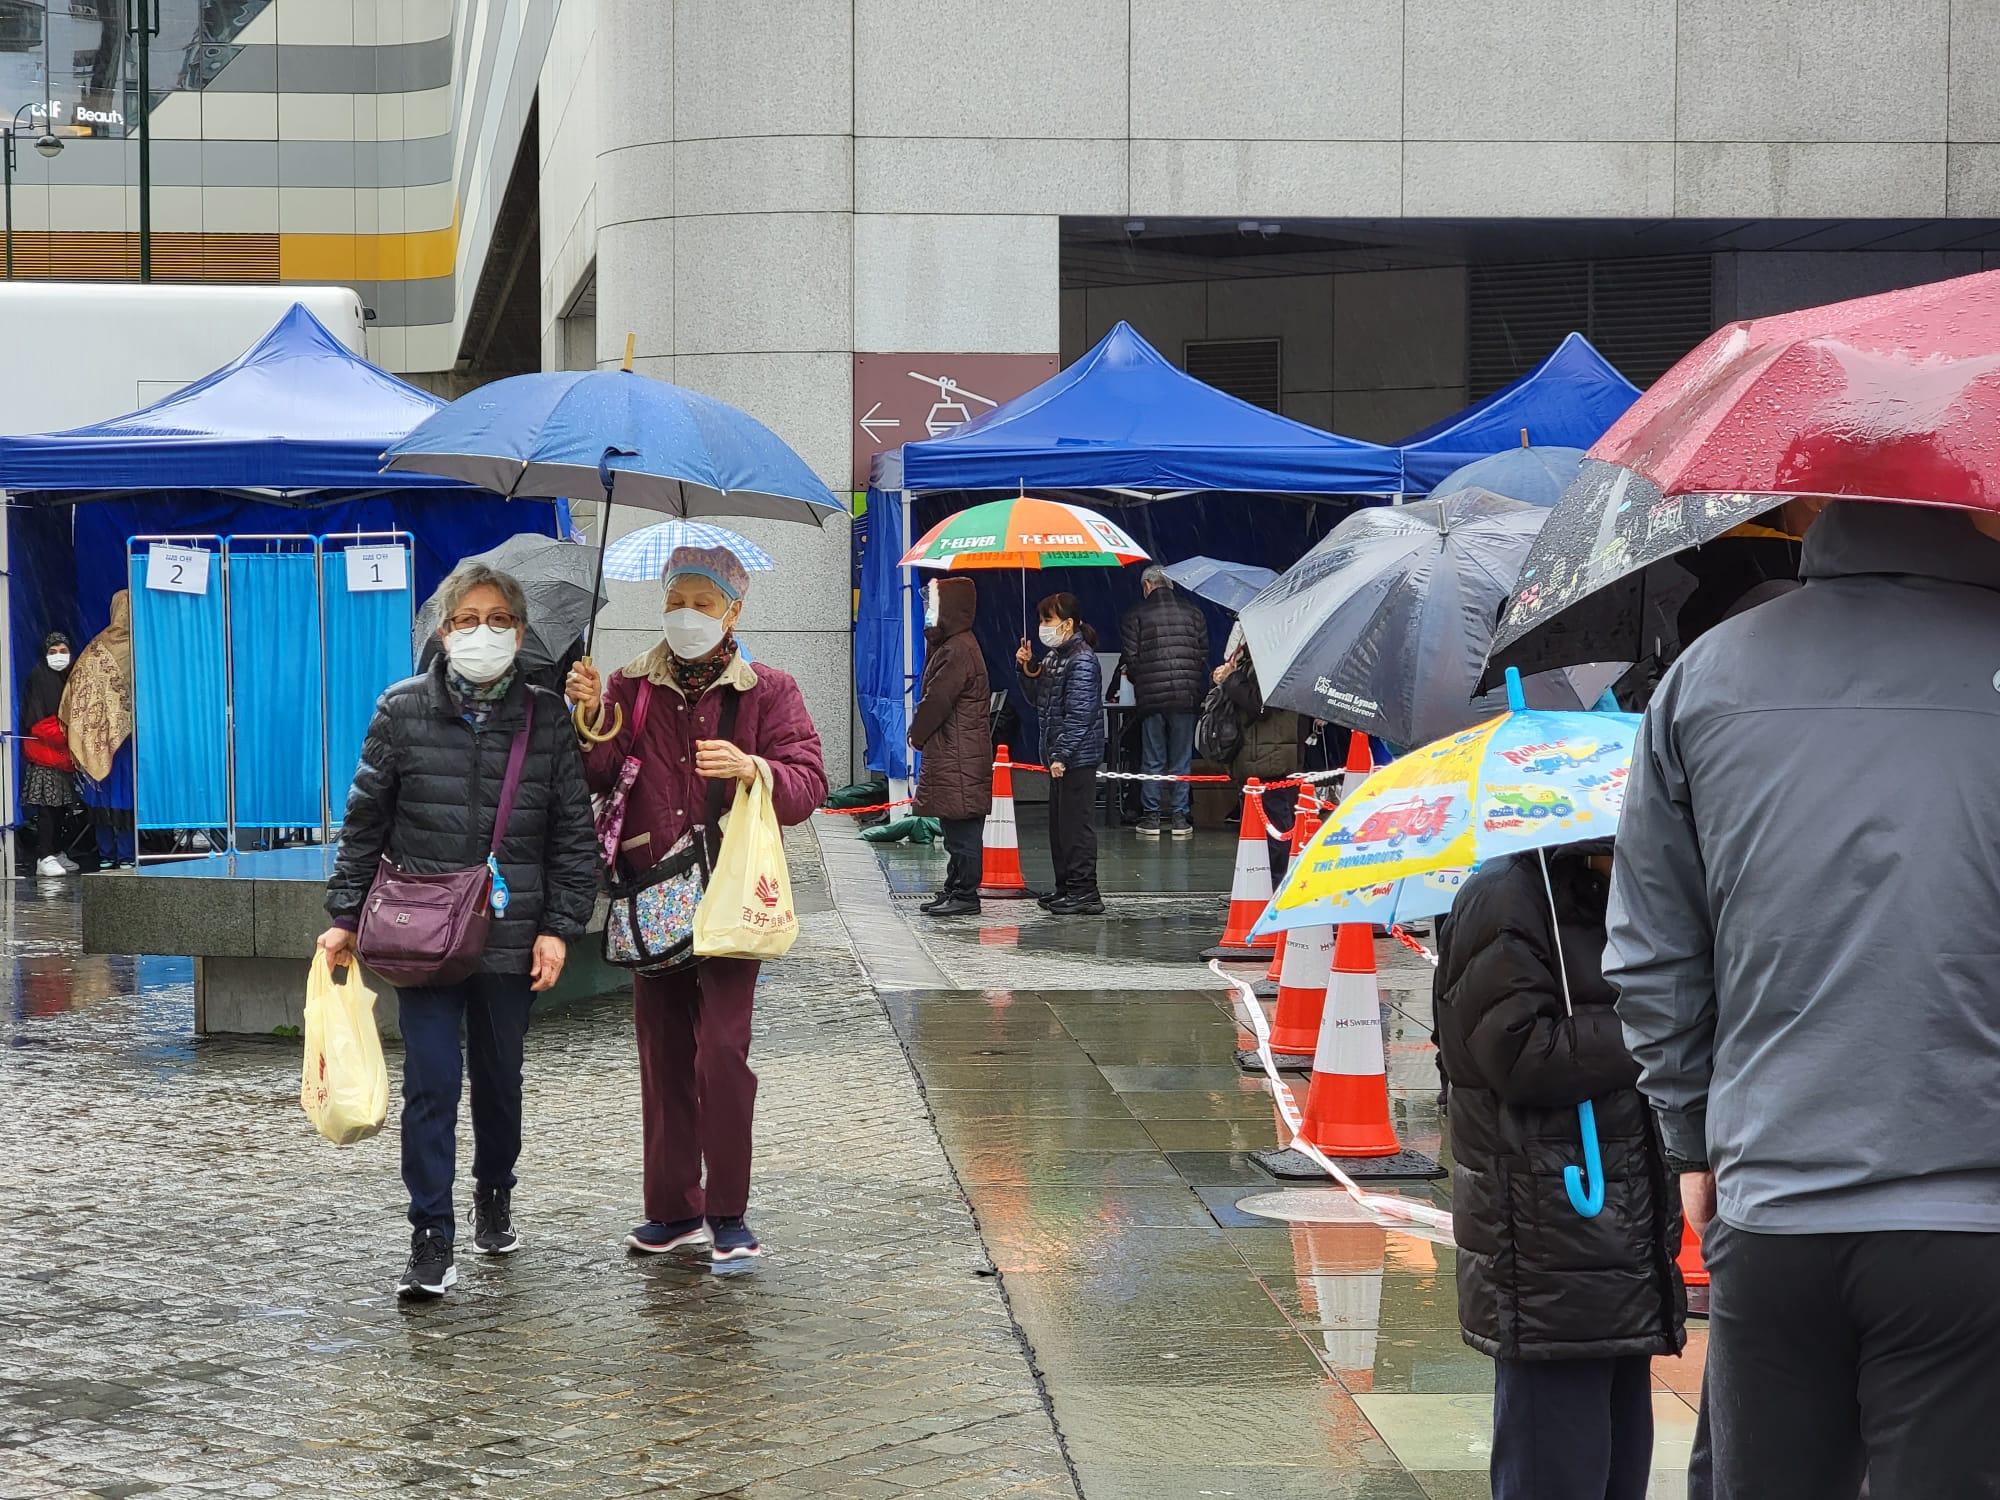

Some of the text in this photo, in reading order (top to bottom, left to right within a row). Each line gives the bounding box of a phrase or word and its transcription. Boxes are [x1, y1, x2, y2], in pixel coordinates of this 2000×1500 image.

[77, 106, 124, 125] Beauty
[170, 564, 183, 584] 2
[370, 563, 383, 582] 1
